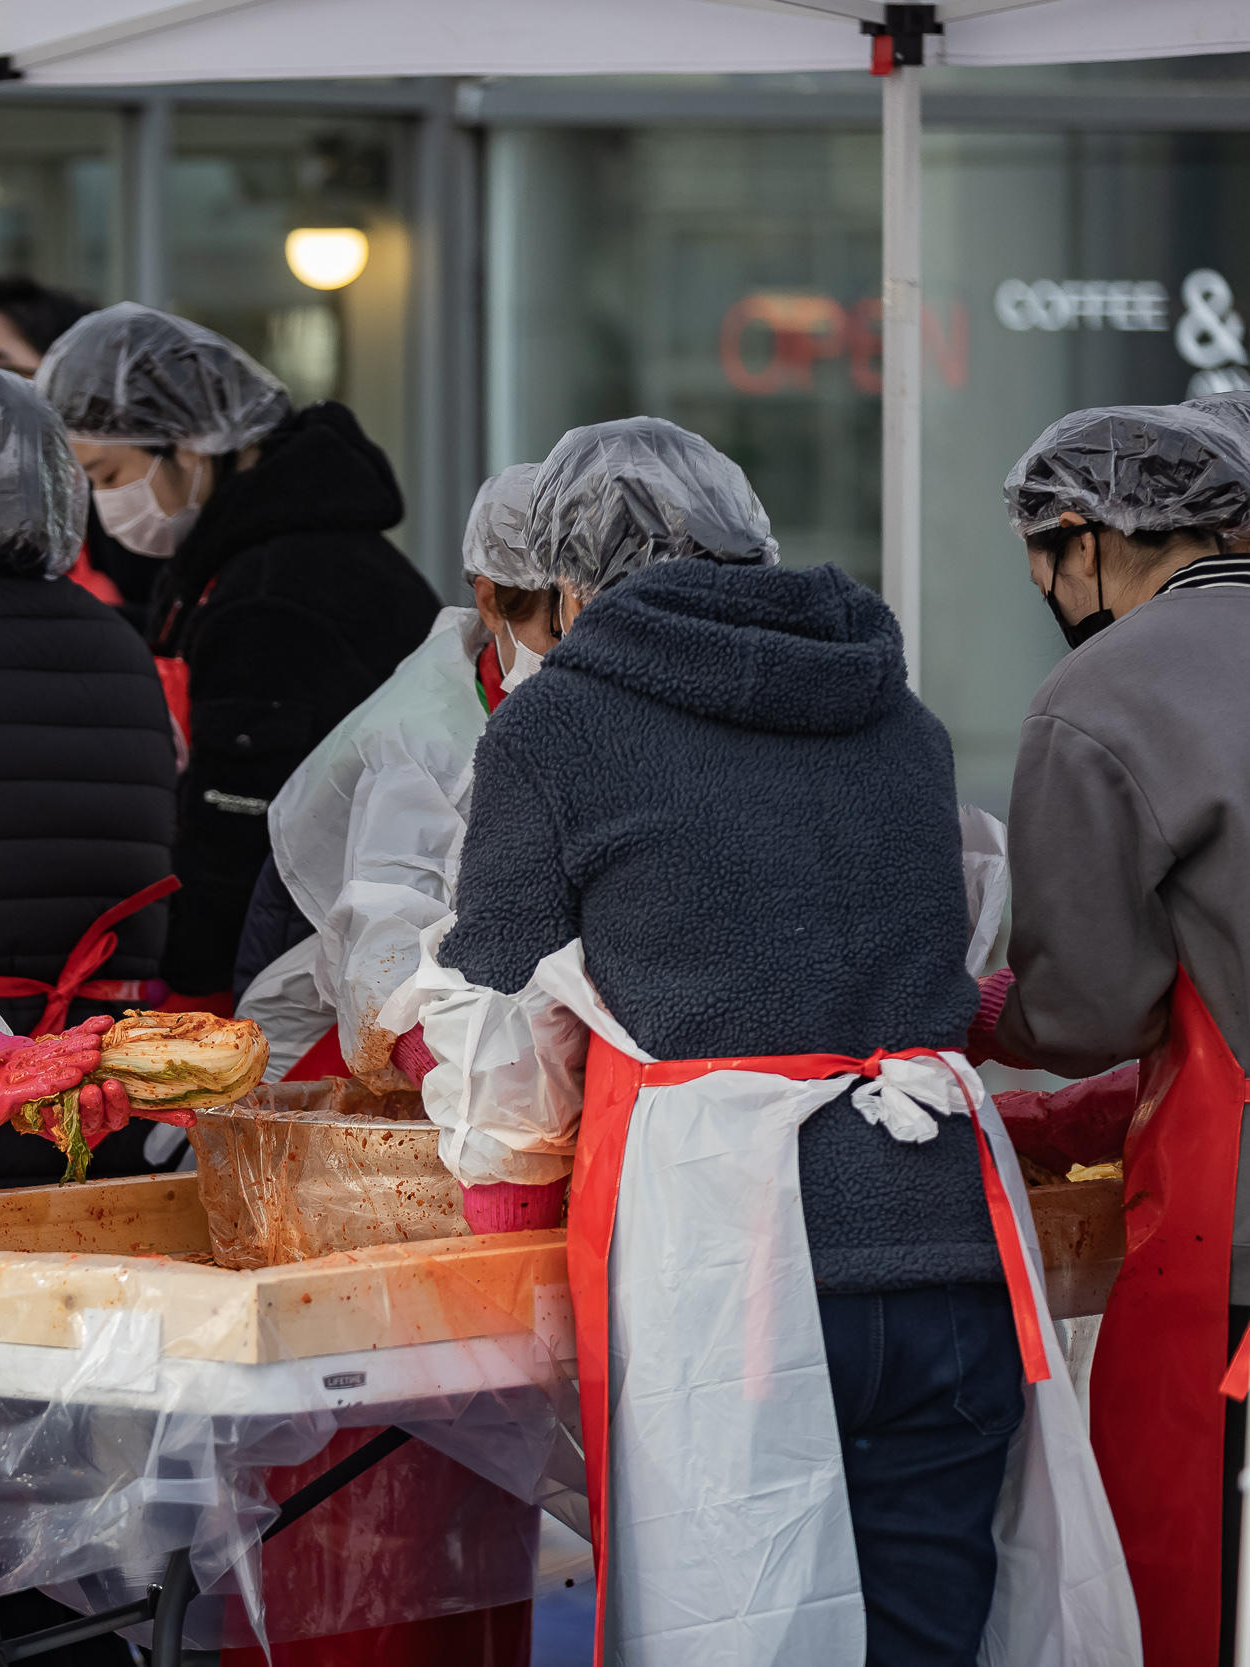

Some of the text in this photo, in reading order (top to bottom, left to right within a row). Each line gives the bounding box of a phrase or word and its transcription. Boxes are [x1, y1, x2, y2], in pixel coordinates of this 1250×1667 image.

[718, 292, 970, 397] OPEN
[994, 266, 1249, 370] COFFEE &
